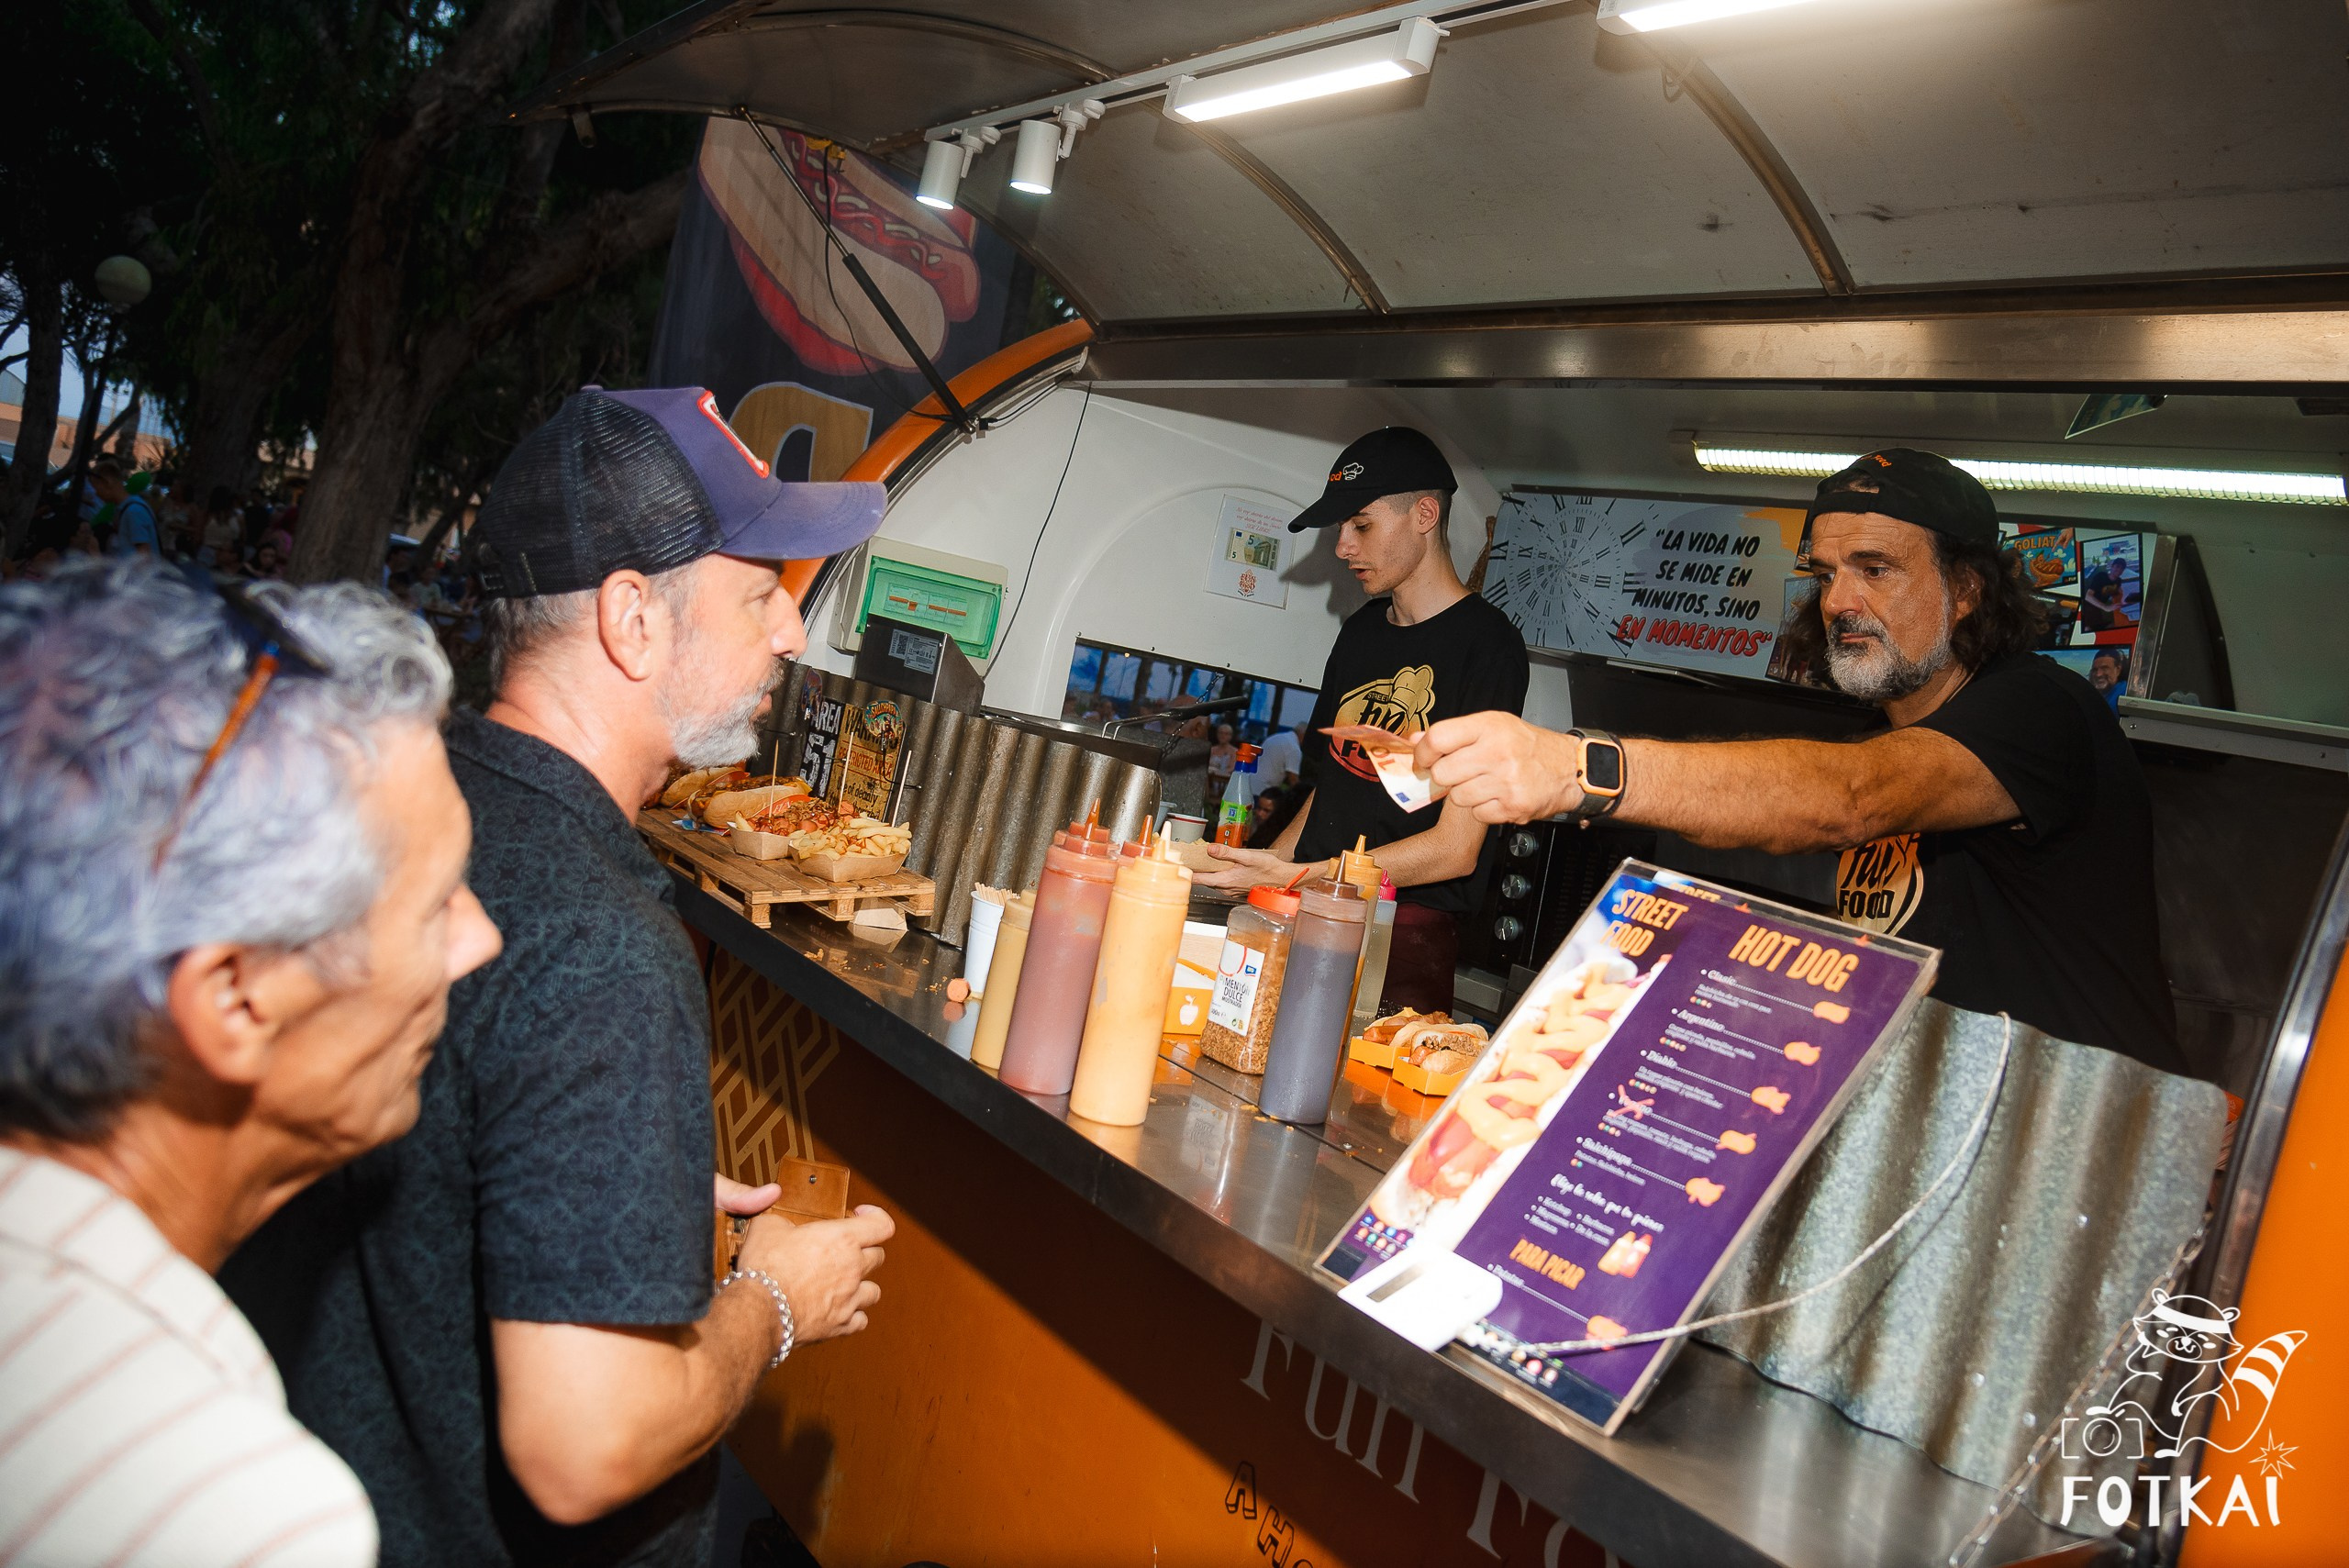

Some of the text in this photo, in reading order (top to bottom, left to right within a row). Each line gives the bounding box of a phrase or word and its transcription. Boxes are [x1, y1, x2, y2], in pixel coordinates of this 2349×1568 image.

[1248, 534, 1255, 546] 5
[1688, 531, 1730, 555] VIDA
[1731, 535, 1760, 558] NO
[2014, 535, 2056, 551] GOLIAT
[1231, 550, 1237, 559] 5
[1655, 560, 1753, 587] SE MIDE EN
[1631, 587, 1761, 621] MINUTOS, SINO
[1616, 613, 1647, 640] EN
[1366, 691, 1390, 703] STREET
[811, 701, 843, 735] AREA
[799, 731, 836, 798] 51
[847, 782, 856, 795] of
[1612, 889, 1689, 931] STREET
[1838, 889, 1896, 920] FOOD
[1601, 921, 1655, 957] FOOD
[1728, 925, 1860, 993] HOT DOG
[1223, 986, 1243, 1004] DULCE
[1677, 1009, 1726, 1033] Argentino
[1646, 1050, 1678, 1070] Diablo
[1582, 1138, 1633, 1166] Salchipapa
[1509, 1238, 1586, 1291] PARA PICAR
